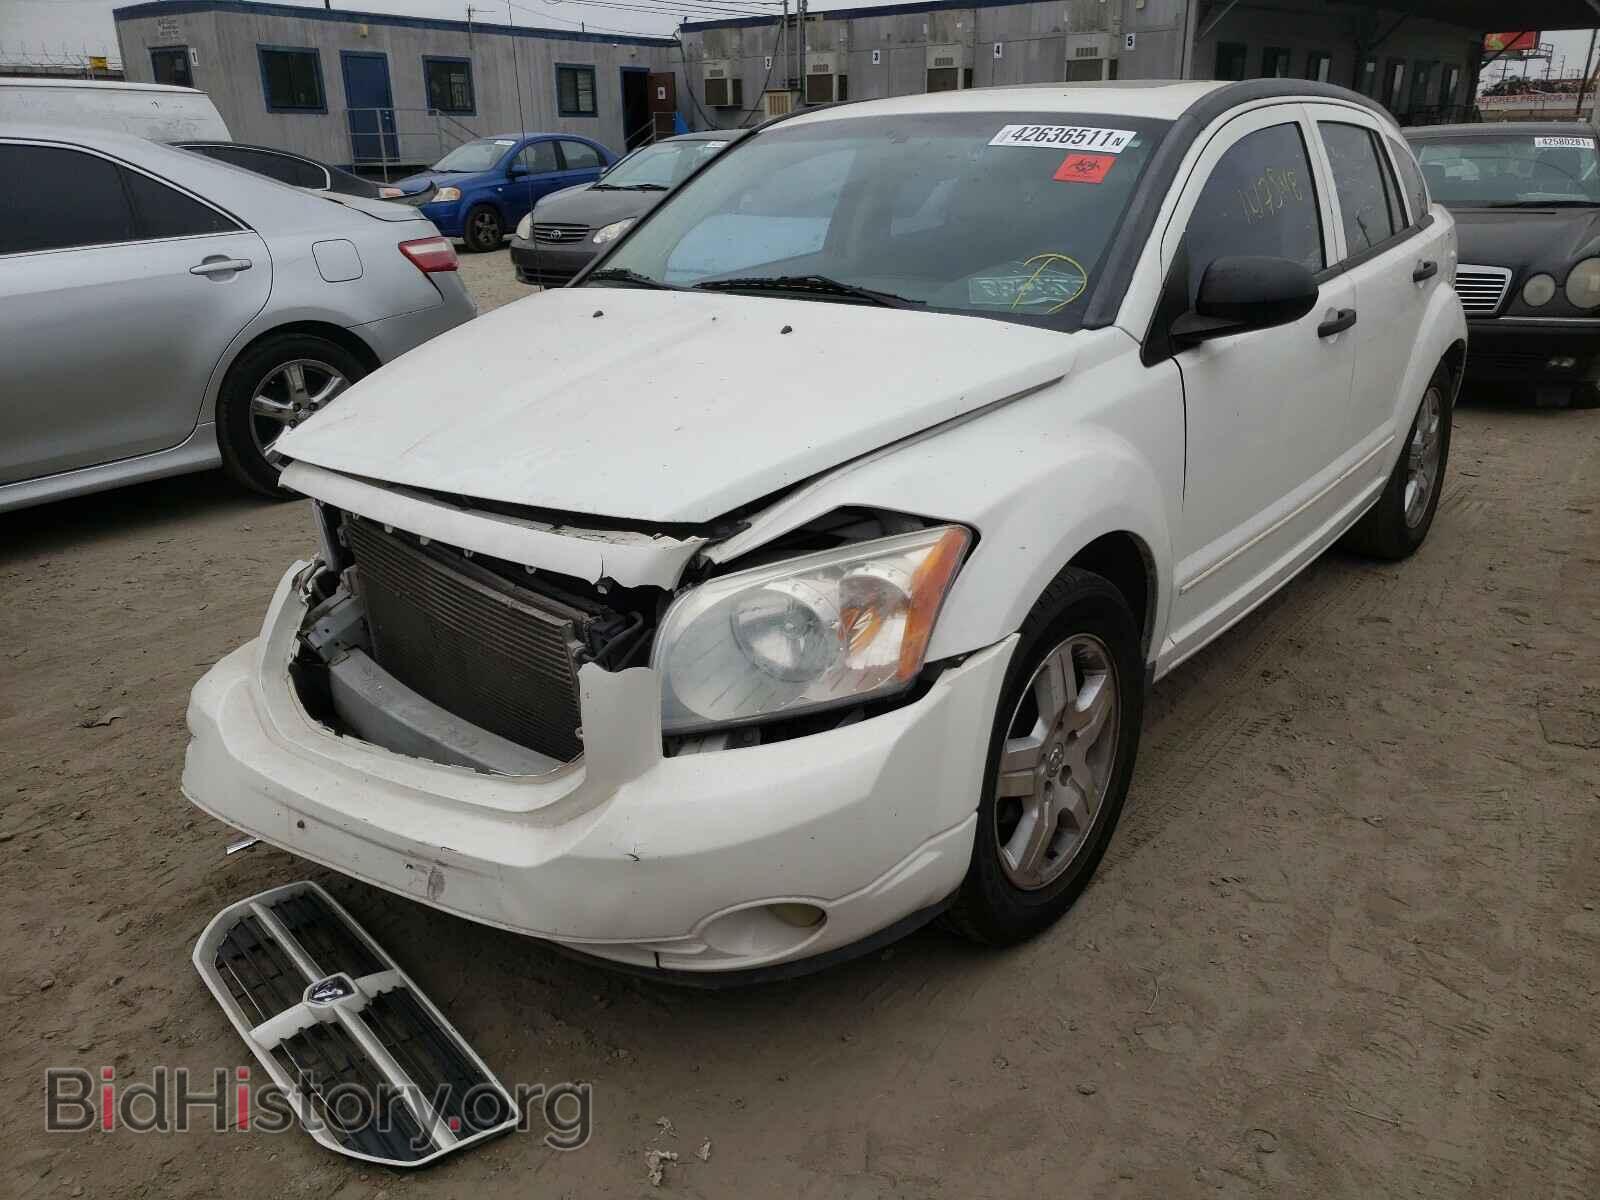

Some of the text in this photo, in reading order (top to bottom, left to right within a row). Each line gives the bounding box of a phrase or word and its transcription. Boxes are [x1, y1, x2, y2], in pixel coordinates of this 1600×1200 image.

[1127, 35, 1133, 46] 5
[1011, 126, 1114, 147] 42636511
[1112, 137, 1124, 146] N
